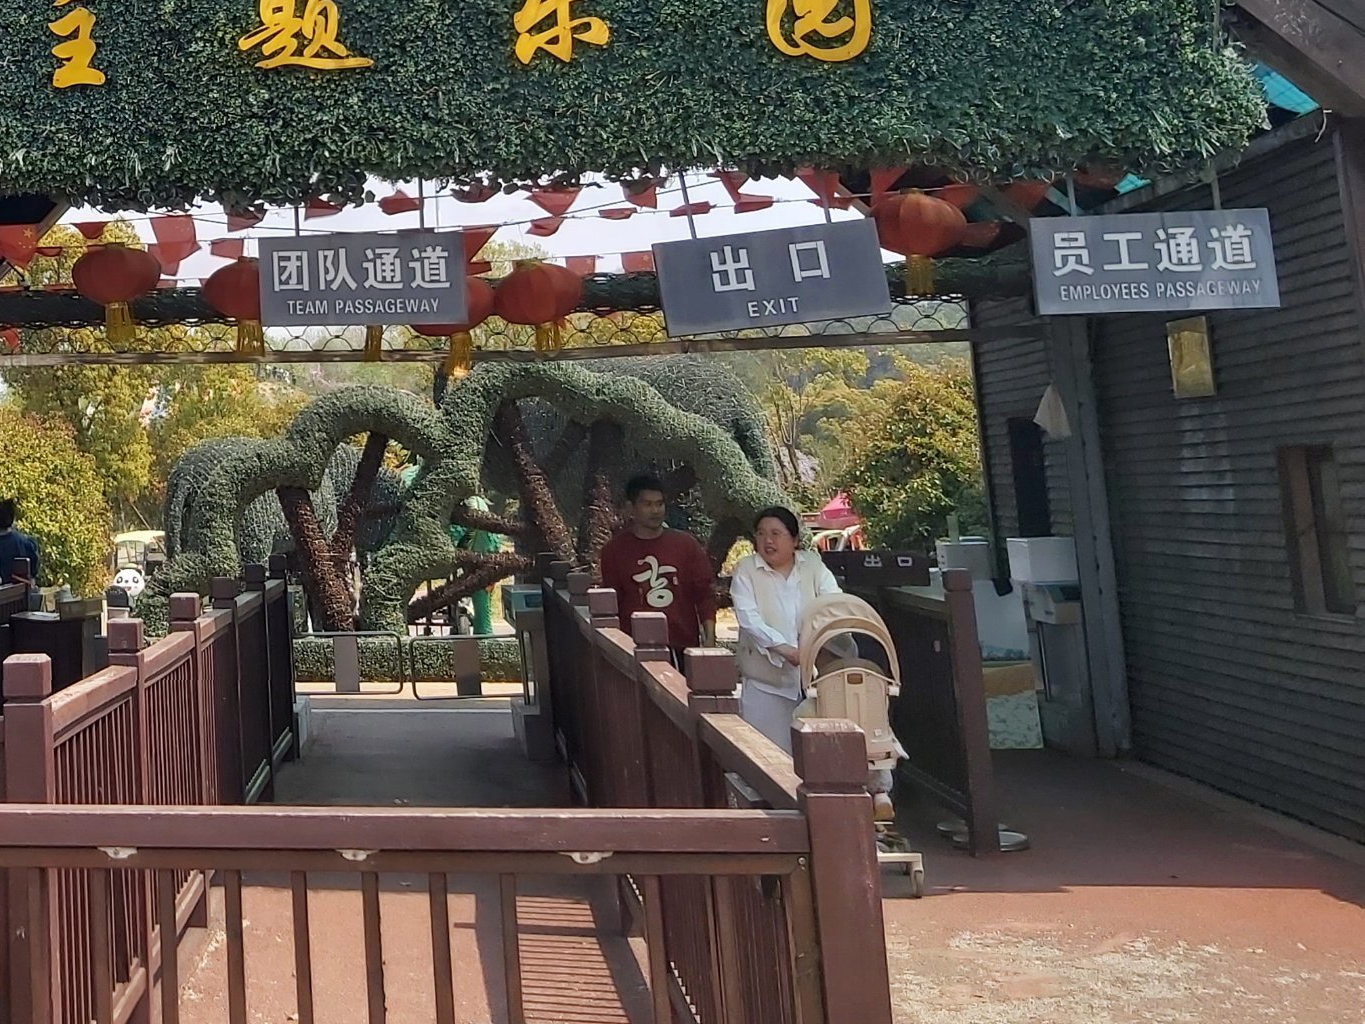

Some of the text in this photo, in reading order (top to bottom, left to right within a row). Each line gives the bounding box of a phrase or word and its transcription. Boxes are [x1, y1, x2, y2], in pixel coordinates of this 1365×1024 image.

[1051, 223, 1257, 278] 员工通道
[271, 246, 451, 292] 团队通道
[710, 240, 831, 294] 出口
[1059, 279, 1261, 301] EMPLOYEES PASSAGEWAY
[287, 298, 440, 315] TEAM PASSAGEWAY
[747, 297, 800, 317] EXIT
[863, 554, 914, 568] 出口
